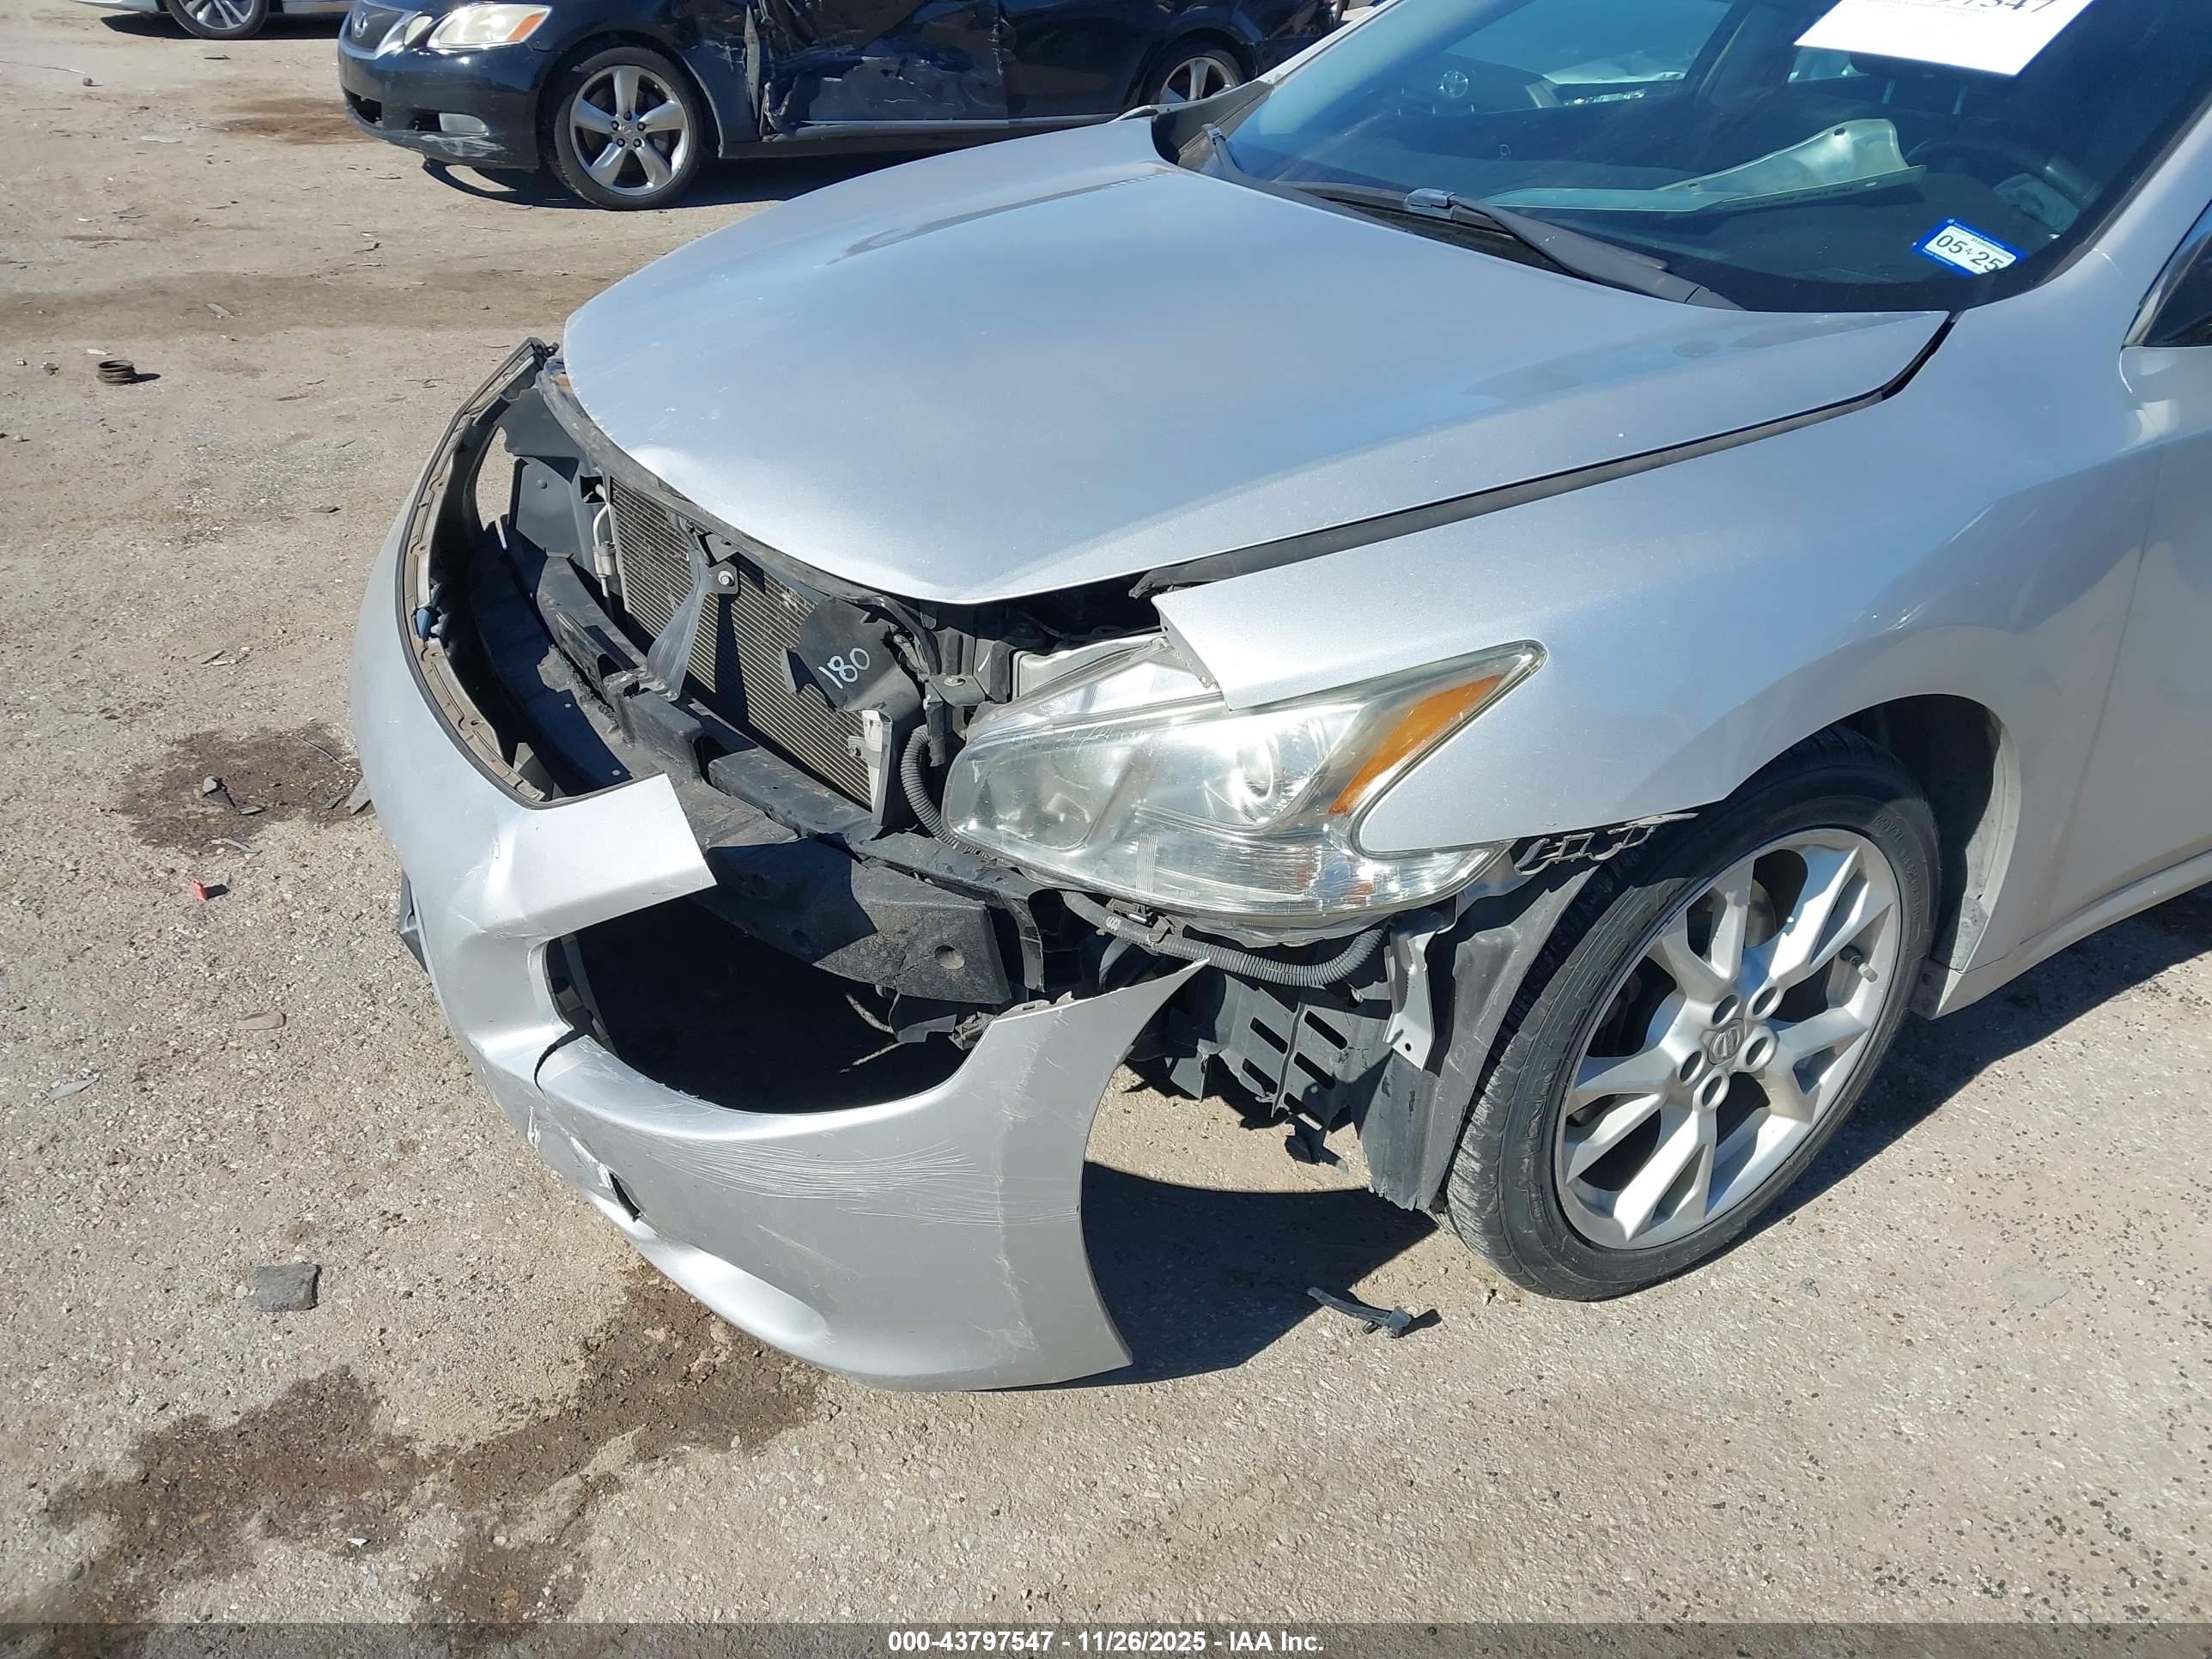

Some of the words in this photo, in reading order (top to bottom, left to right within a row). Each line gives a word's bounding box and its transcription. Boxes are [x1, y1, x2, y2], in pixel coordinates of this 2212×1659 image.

[1936, 234, 1968, 253] 05
[1970, 251, 2004, 271] 25
[817, 647, 870, 689] 180
